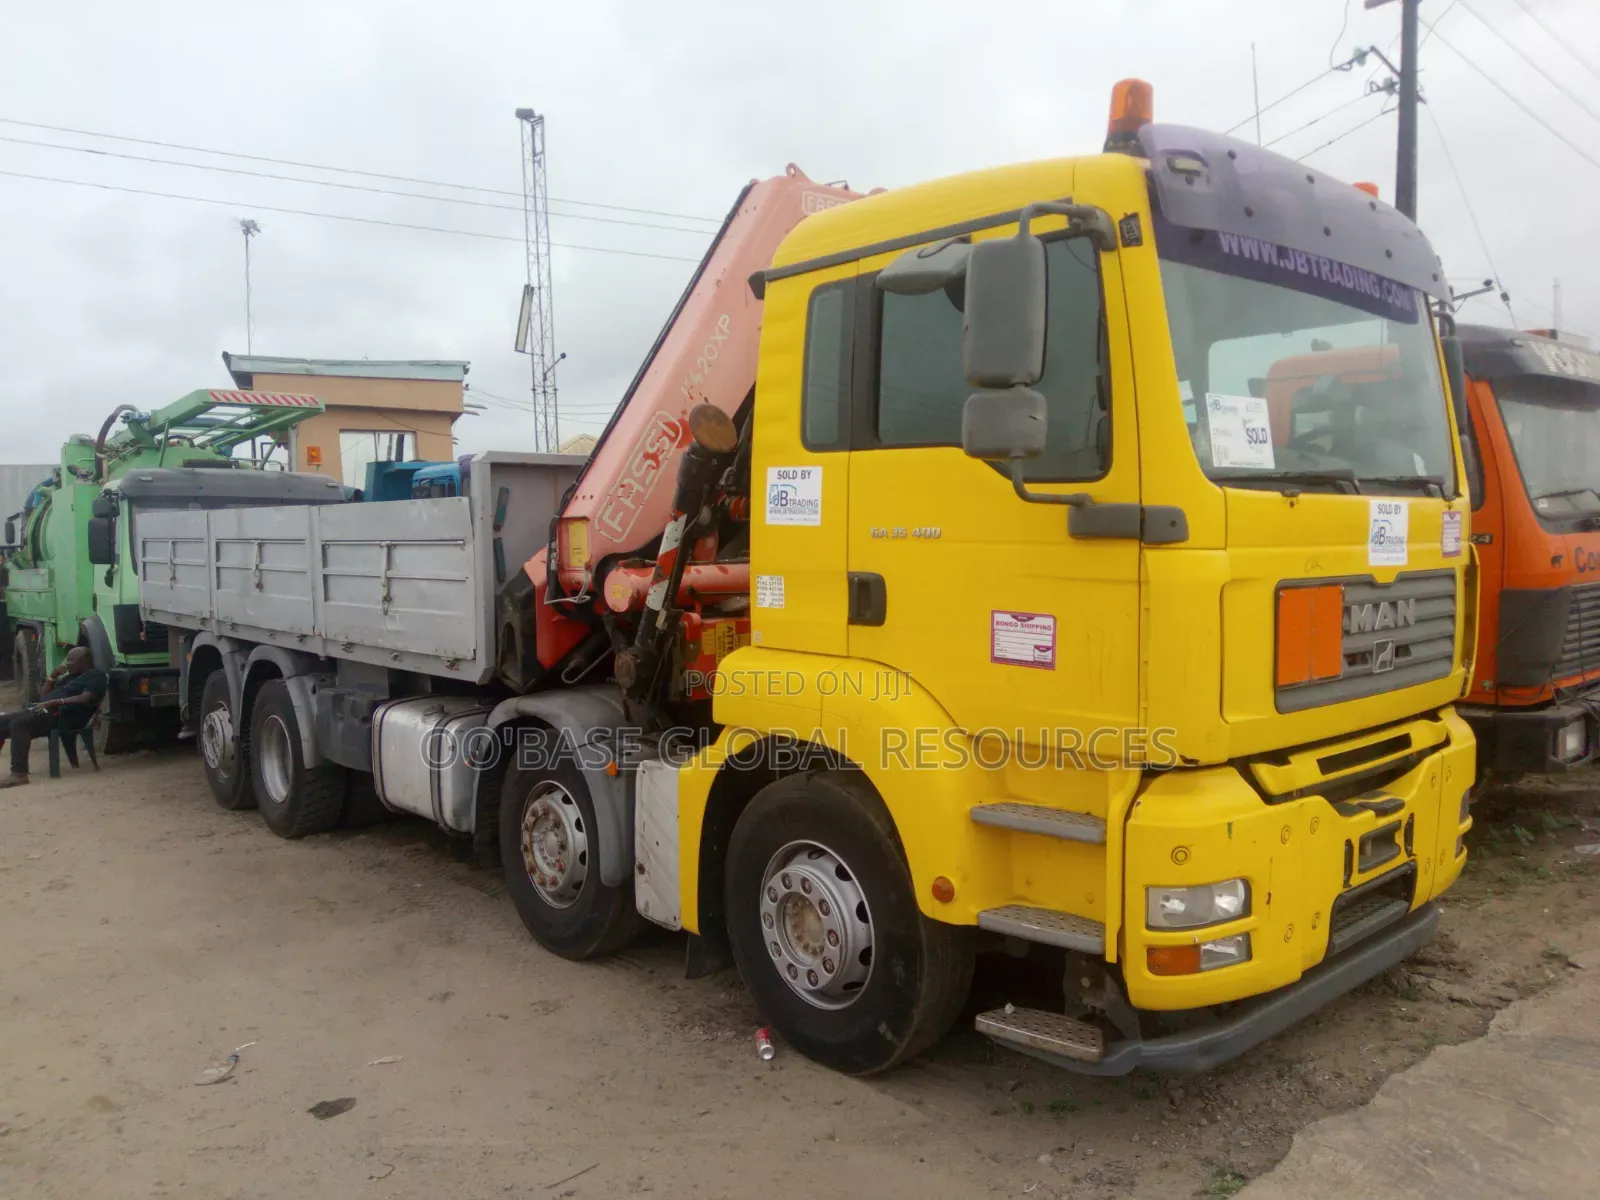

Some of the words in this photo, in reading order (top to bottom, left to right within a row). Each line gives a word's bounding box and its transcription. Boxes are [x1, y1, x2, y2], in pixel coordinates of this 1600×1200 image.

[1218, 231, 1412, 313] WWW.JBTRADING.COM
[1246, 427, 1268, 445] SOLD
[602, 419, 676, 533] FASSI
[776, 470, 798, 480] SOLD
[801, 469, 812, 480] BY
[789, 498, 819, 508] TRADING
[1377, 503, 1393, 515] SOLD
[1394, 504, 1402, 515] BY
[891, 527, 908, 540] 35
[911, 527, 942, 540] 400
[1351, 598, 1416, 634] MAN
